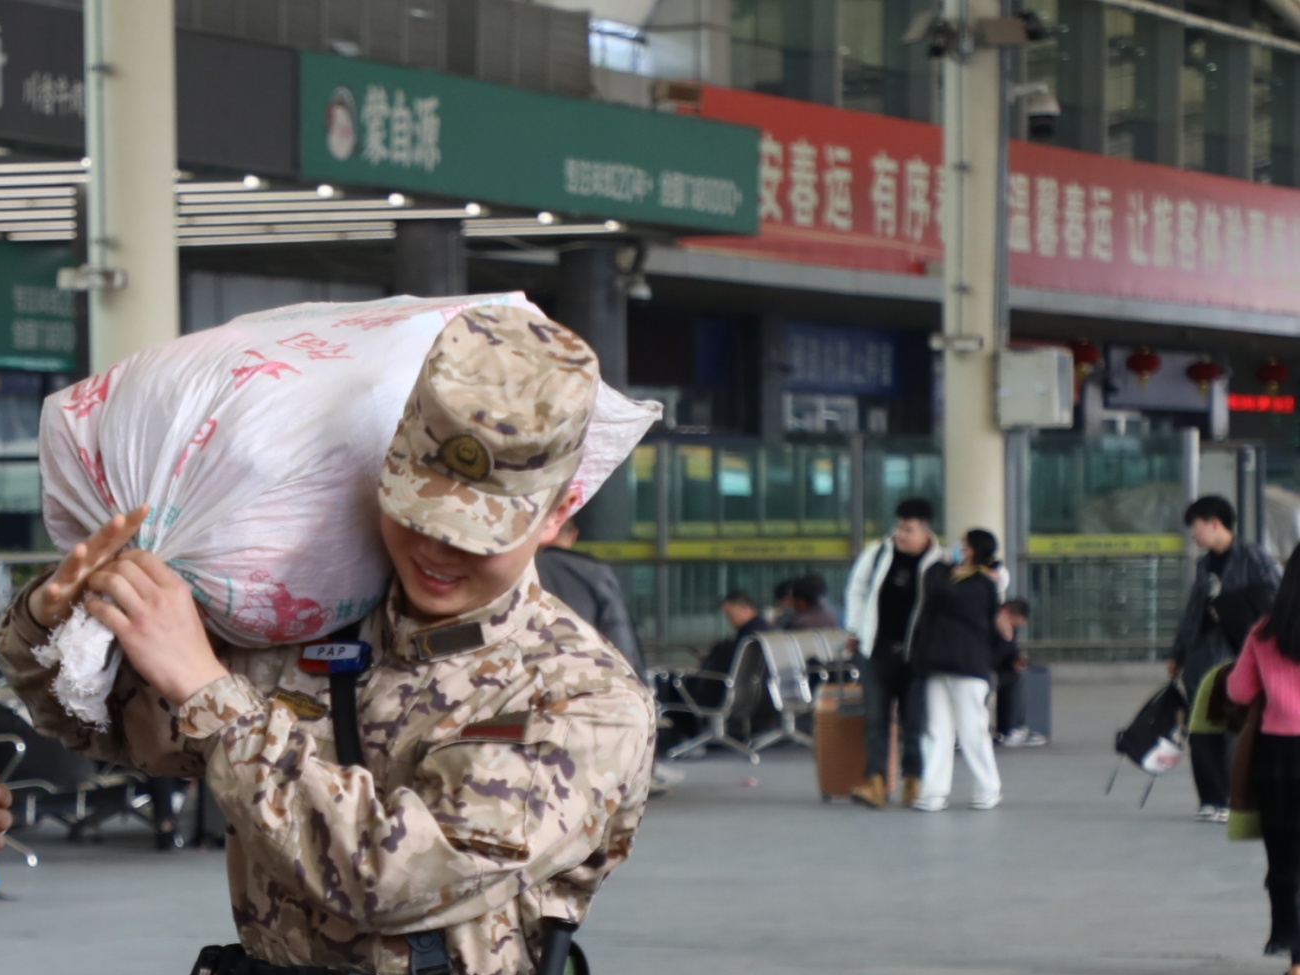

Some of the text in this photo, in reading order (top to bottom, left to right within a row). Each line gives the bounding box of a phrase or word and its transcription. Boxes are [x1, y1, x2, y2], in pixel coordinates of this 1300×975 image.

[361, 83, 442, 173] 蒙自源
[869, 150, 947, 244] 有序
[317, 646, 346, 657] PAP
